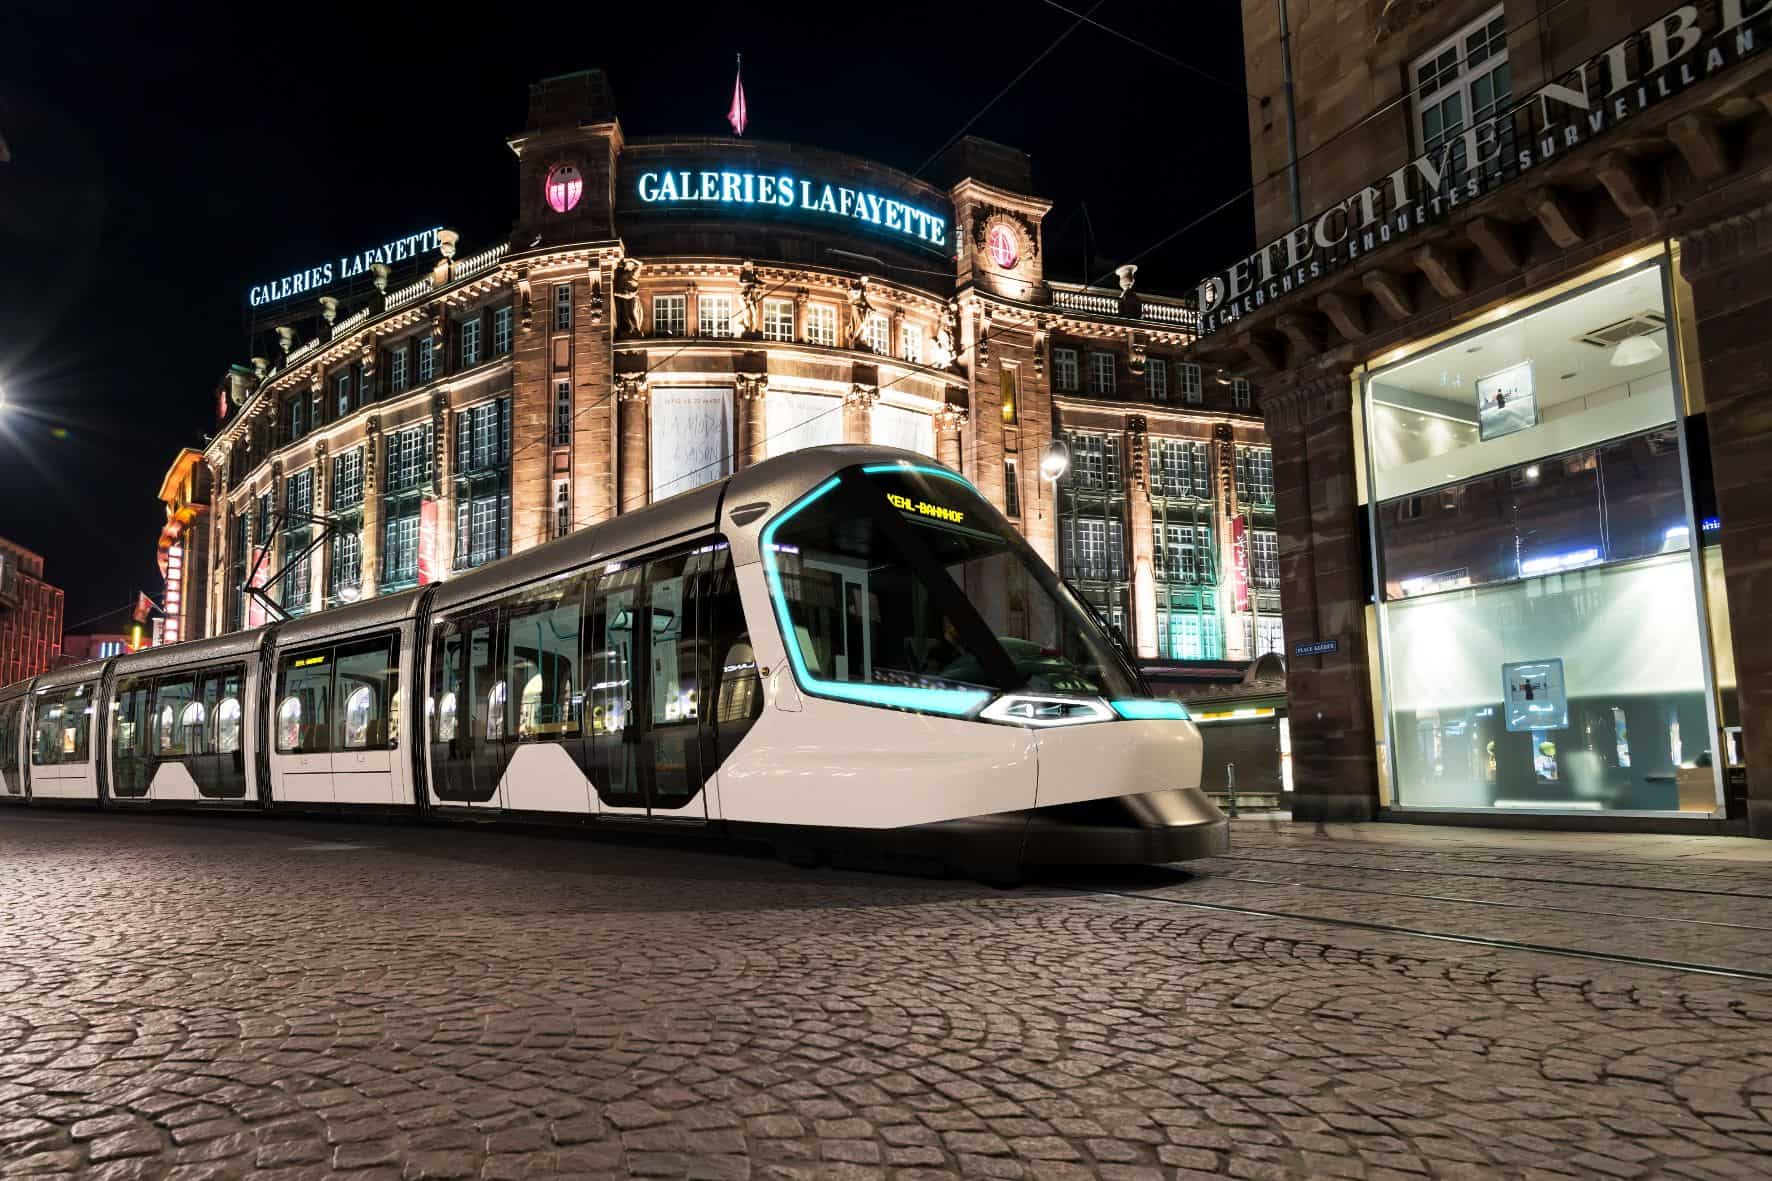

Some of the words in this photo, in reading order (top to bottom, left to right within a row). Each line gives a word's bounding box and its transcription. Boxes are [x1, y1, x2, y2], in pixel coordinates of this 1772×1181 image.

[638, 171, 795, 208] GALERIES
[800, 180, 945, 246] LAFAYETTE
[1195, 116, 1502, 313] DETECTIVE
[250, 263, 333, 307] GALERIES
[341, 226, 444, 279] LAFAYETTE
[1196, 261, 1320, 338] RECHERCHES
